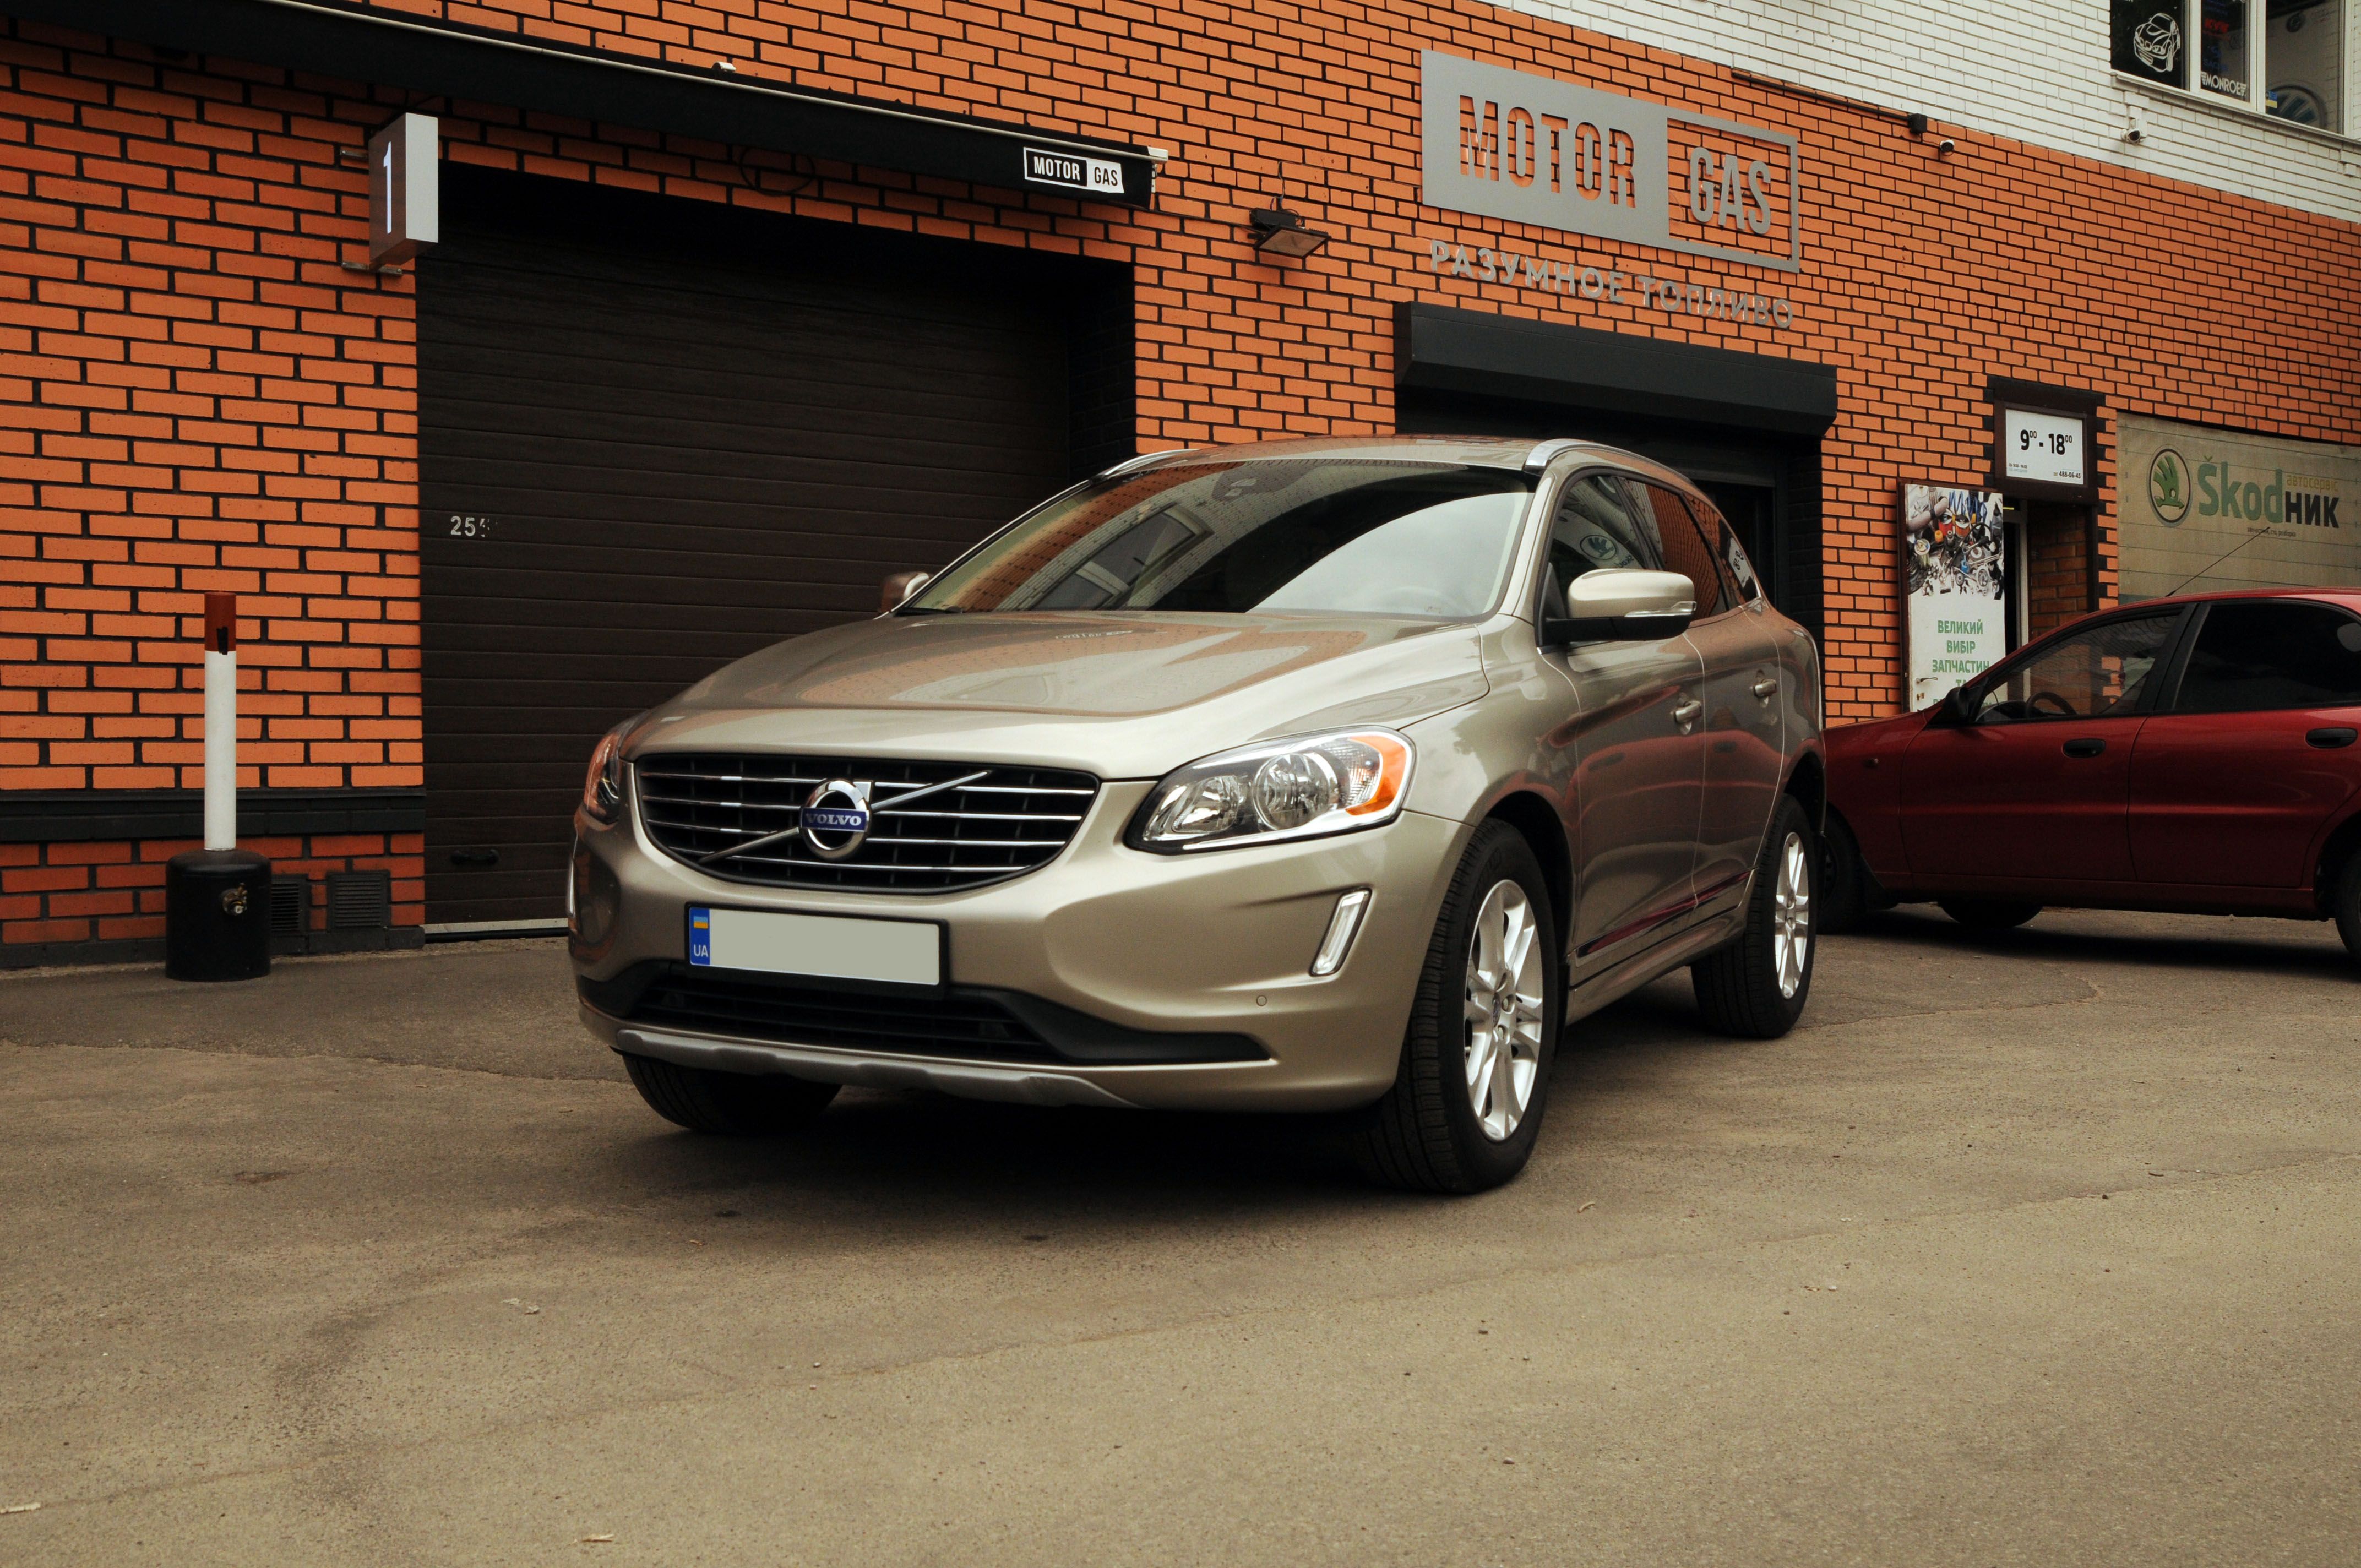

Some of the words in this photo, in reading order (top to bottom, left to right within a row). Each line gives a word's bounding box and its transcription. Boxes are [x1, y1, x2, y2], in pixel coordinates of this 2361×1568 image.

[2206, 73, 2242, 95] MONROE
[1033, 156, 1081, 181] MOTOR
[1094, 166, 1118, 186] GAS
[1460, 95, 1636, 209] MOTOR
[1690, 146, 1771, 235] GAS
[383, 141, 392, 235] 1
[1430, 239, 1626, 304] РАЗУМНОЕ
[1637, 276, 1794, 329] ТОПЛИВО
[2287, 475, 2338, 492] автосервіс
[1938, 619, 1984, 635] ВЕЛИКИЙ
[1946, 640, 1976, 654] ВИБІР
[1932, 659, 1990, 673] ЗАПЧАСТИН
[804, 813, 863, 827] VOLVO
[693, 944, 709, 958] UA
